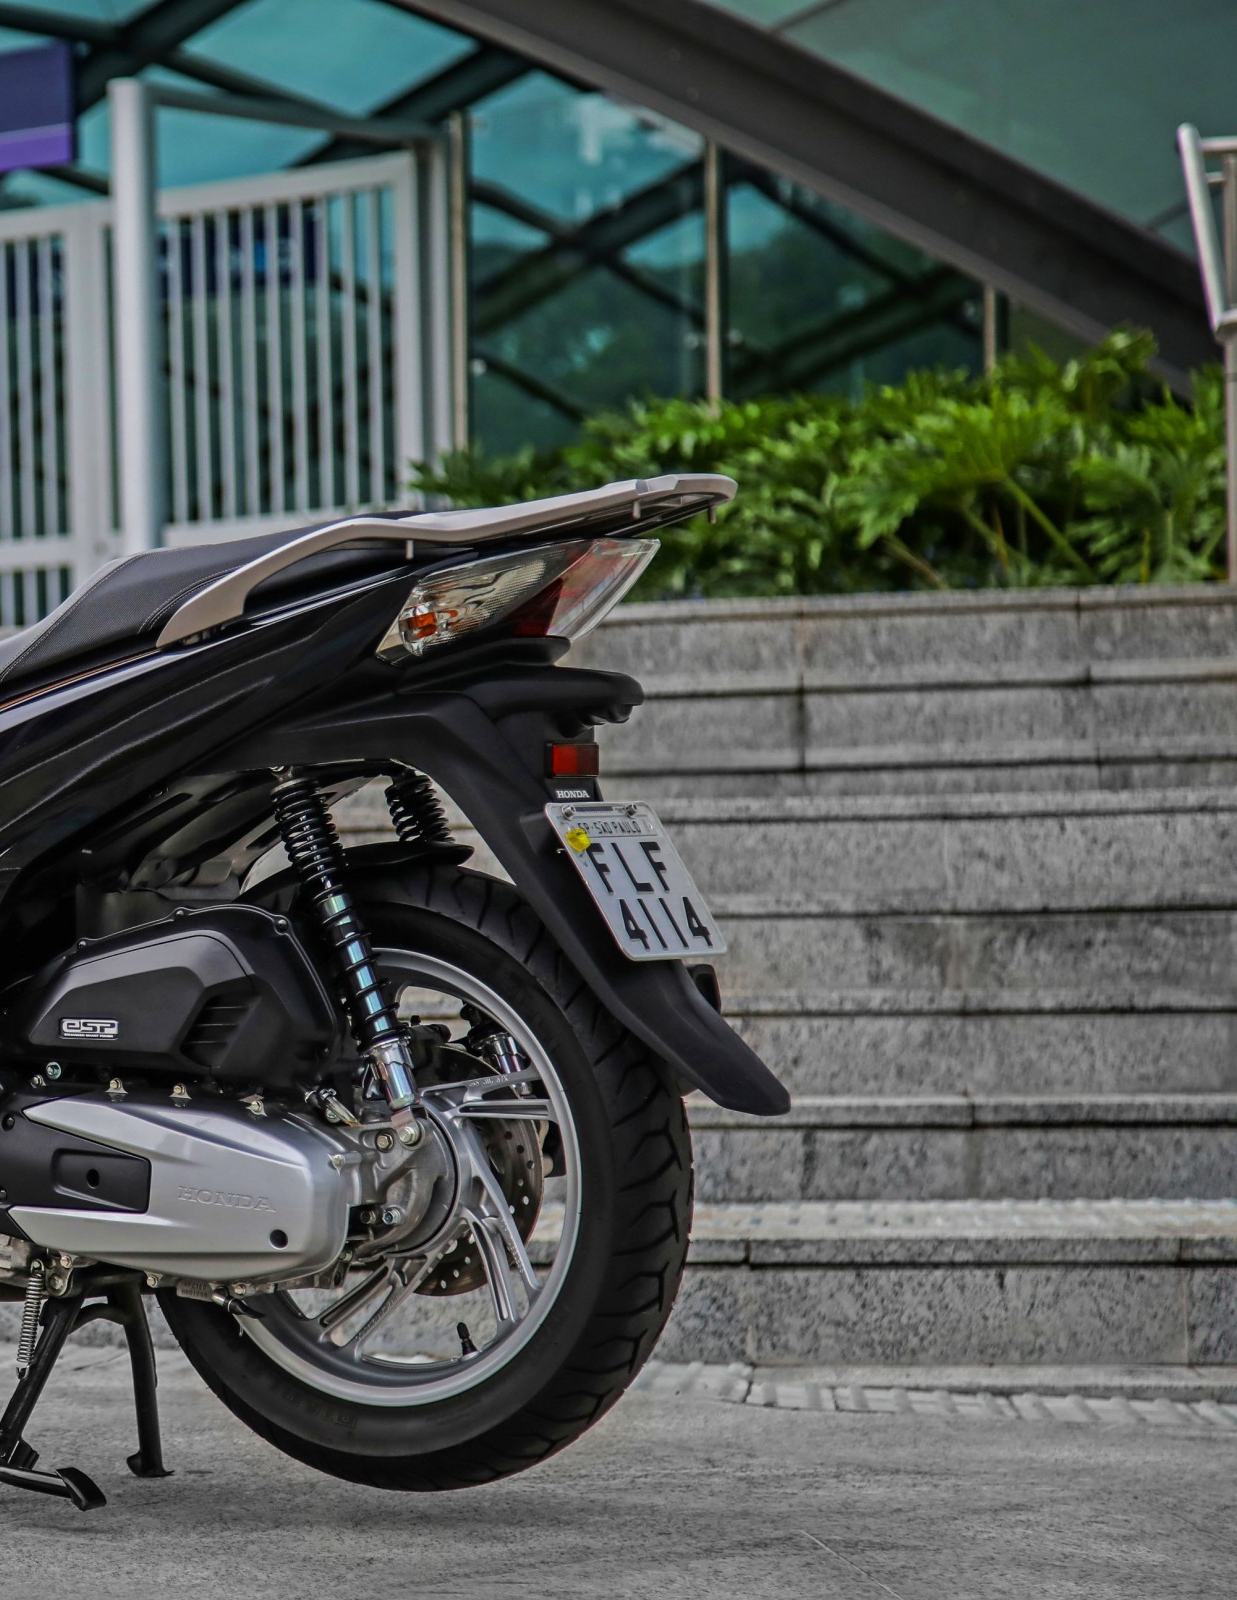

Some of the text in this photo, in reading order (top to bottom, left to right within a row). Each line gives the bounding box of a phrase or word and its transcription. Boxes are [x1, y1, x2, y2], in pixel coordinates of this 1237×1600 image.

[556, 790, 590, 799] HONDA
[611, 820, 642, 834] PAULO
[585, 841, 671, 895] FLF
[619, 896, 714, 951] 4114
[178, 1186, 276, 1212] HONDA
